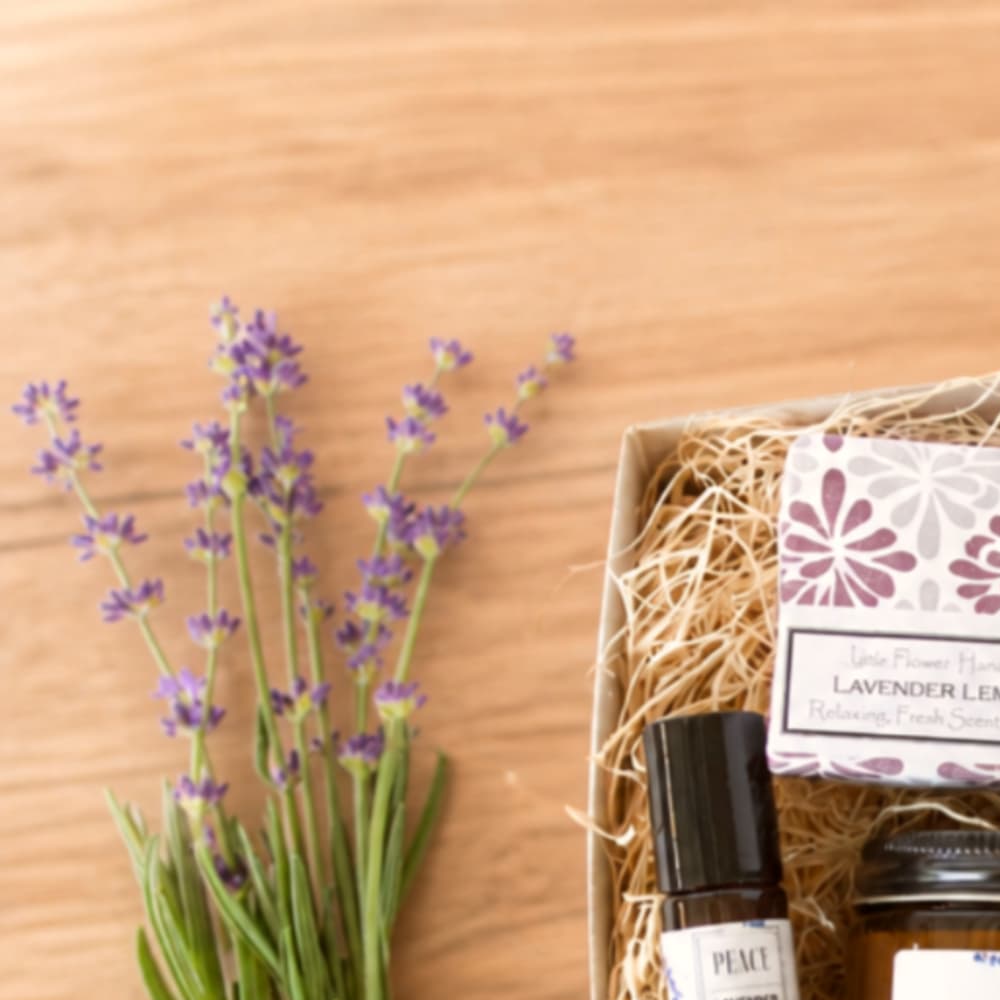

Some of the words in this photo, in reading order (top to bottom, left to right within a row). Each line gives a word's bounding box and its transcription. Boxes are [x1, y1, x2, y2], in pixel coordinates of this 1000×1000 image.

[893, 647, 950, 671] Flower
[833, 675, 956, 699] LAVENDER
[896, 703, 945, 727] Fresh
[712, 946, 771, 976] PEACE
